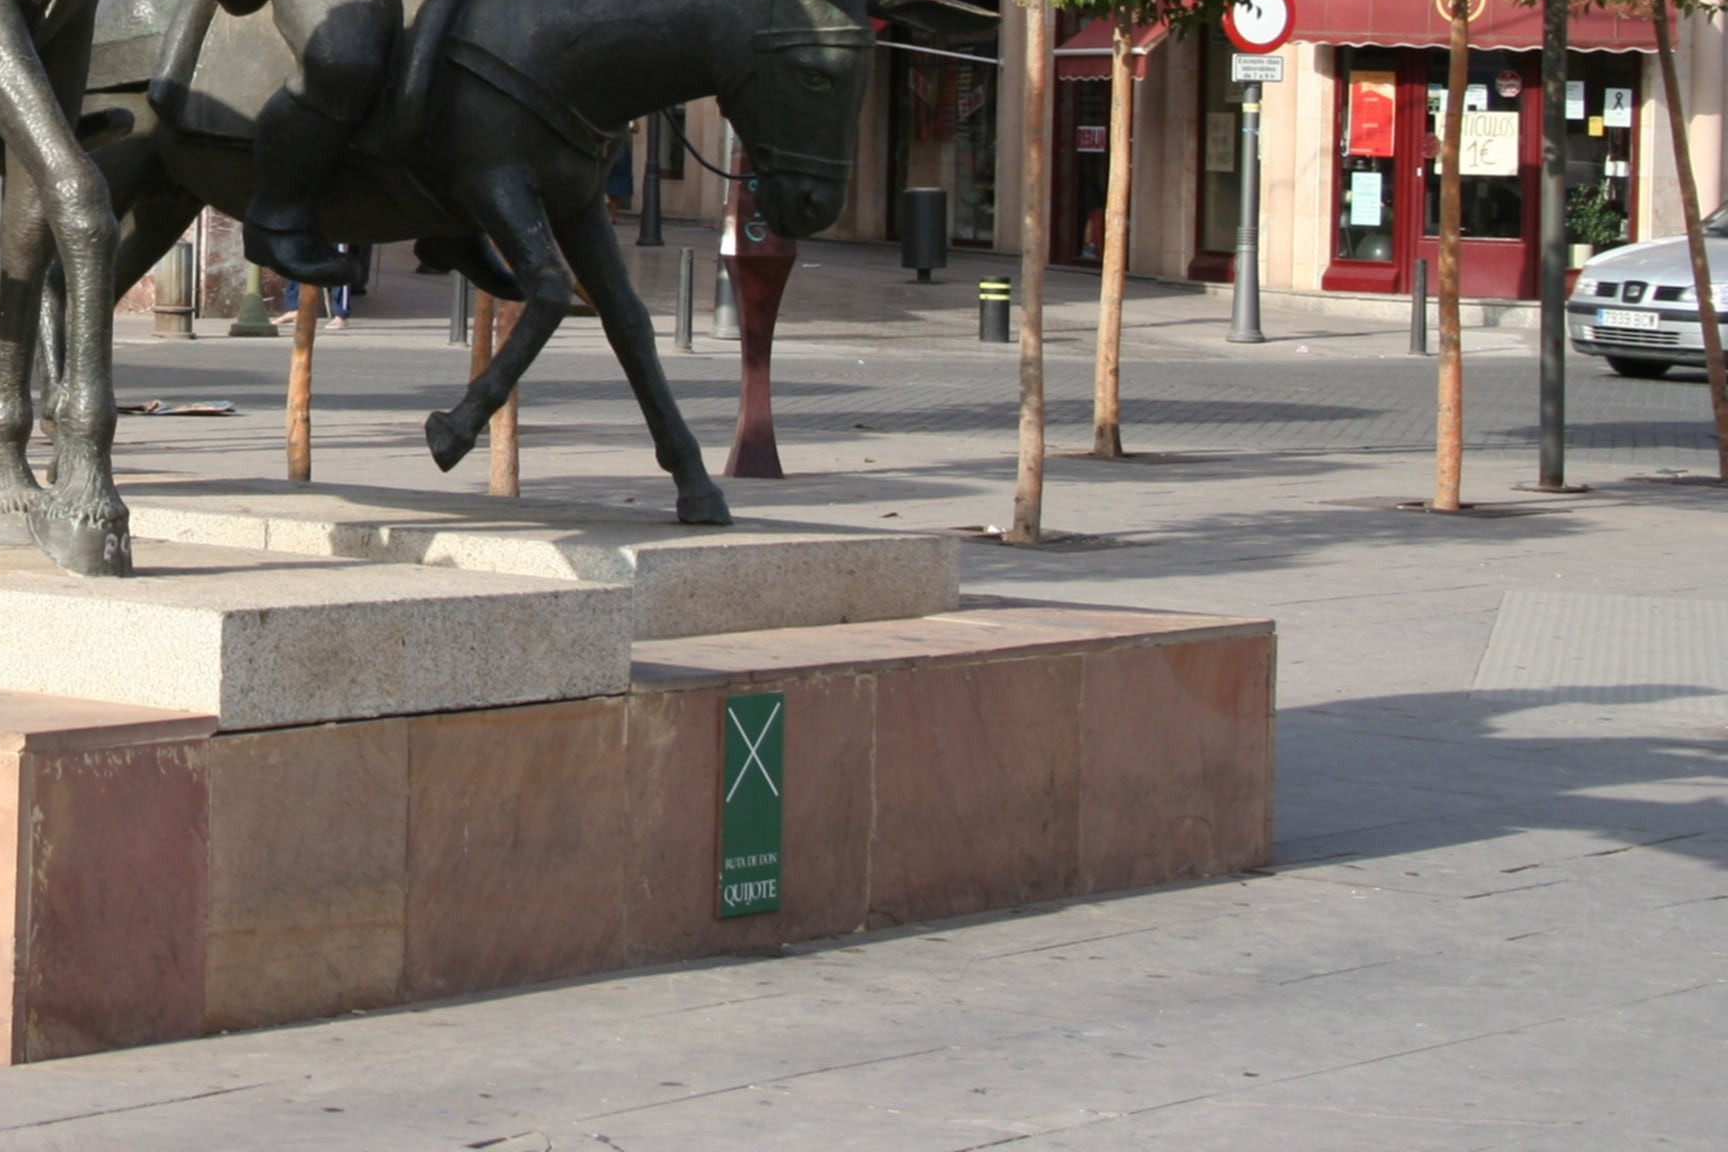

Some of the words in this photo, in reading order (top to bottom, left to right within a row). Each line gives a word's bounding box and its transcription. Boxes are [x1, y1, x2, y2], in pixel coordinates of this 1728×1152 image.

[725, 856, 746, 870] RUTA
[747, 854, 758, 867] DE
[759, 851, 777, 866] DON
[724, 878, 777, 907] QUIJOTE
